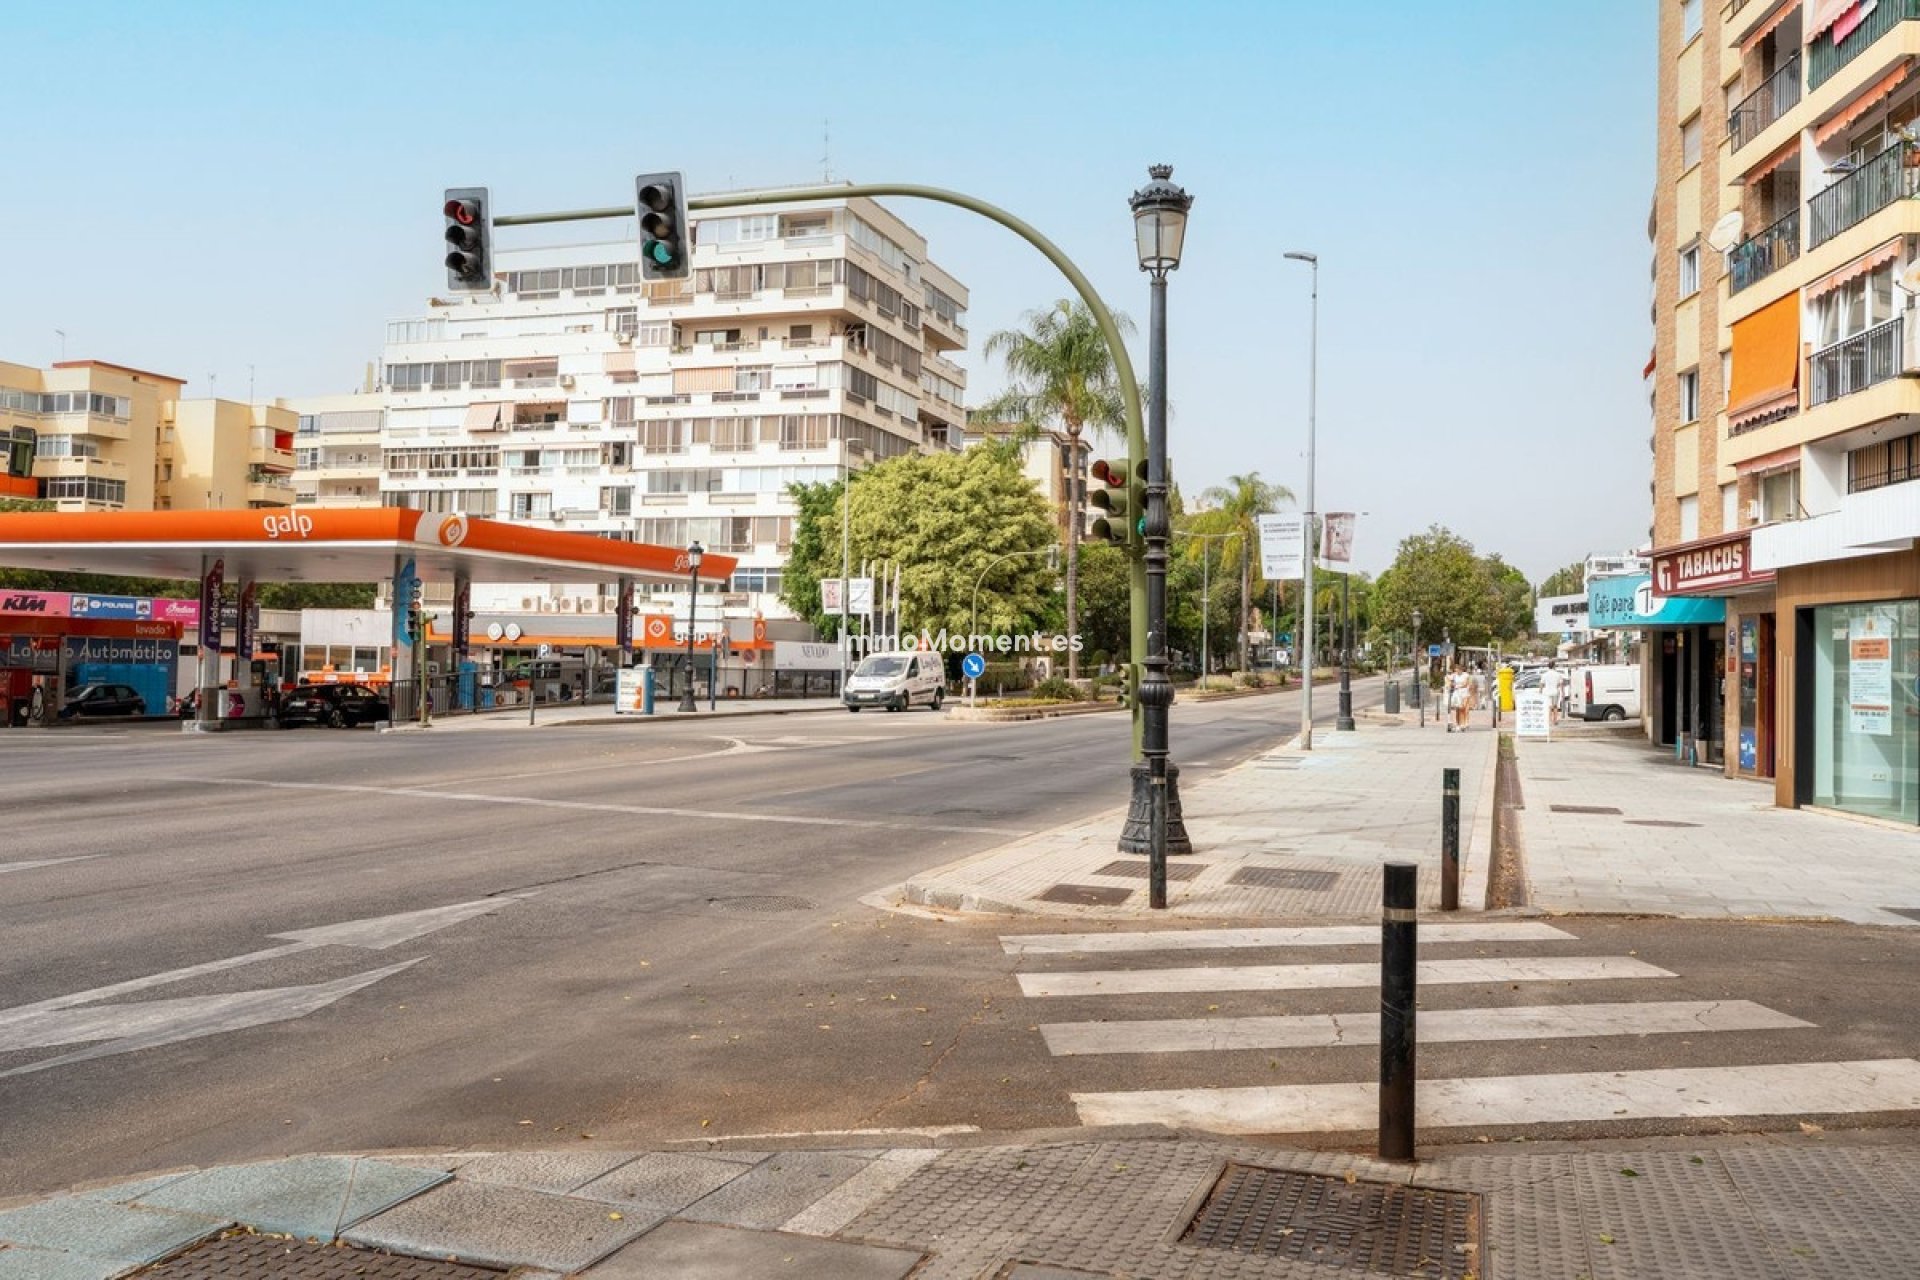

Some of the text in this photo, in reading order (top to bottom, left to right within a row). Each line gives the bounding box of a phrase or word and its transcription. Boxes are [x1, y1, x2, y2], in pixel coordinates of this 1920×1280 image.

[263, 510, 313, 538] galp
[1677, 543, 1743, 580] TABACOS
[2, 594, 48, 612] KTM
[1612, 596, 1634, 619] para
[79, 638, 172, 660] Automático
